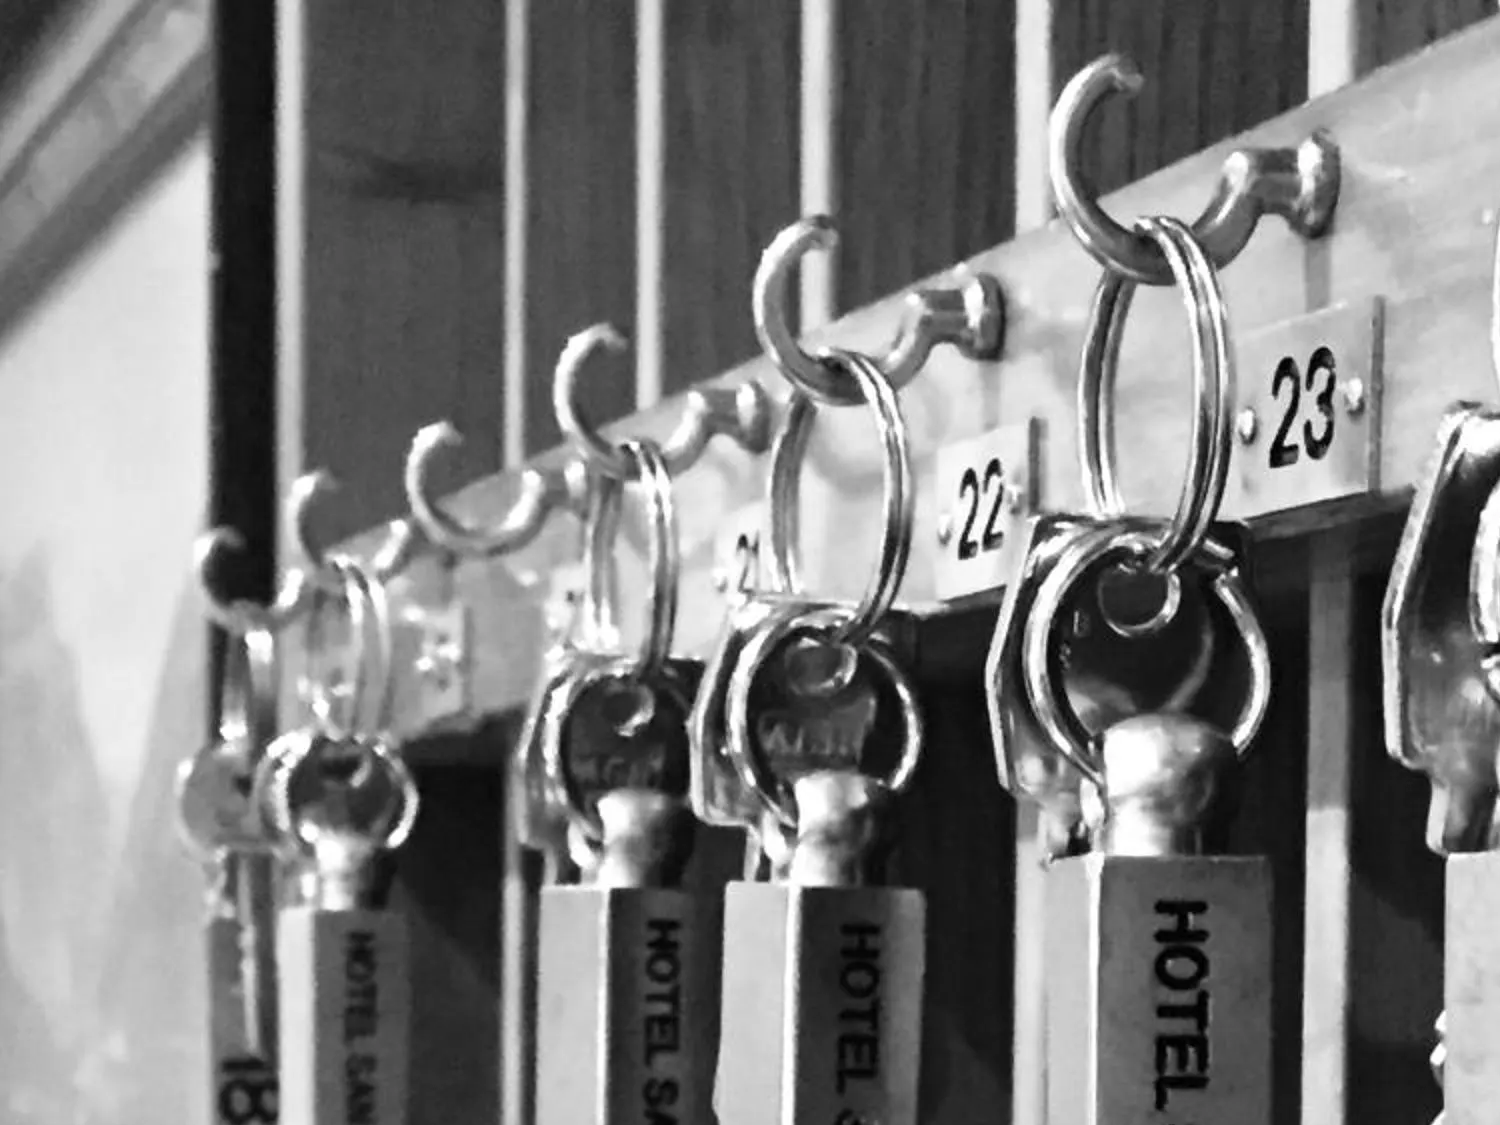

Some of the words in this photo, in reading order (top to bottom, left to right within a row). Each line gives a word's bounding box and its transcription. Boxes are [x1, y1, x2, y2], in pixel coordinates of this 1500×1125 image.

[1268, 346, 1337, 469] 23
[957, 458, 1004, 562] 22
[344, 931, 378, 1046] HOTEL
[643, 918, 684, 1067] HOTEL
[835, 923, 881, 1096] HOTEL
[1153, 899, 1210, 1112] HOTEL
